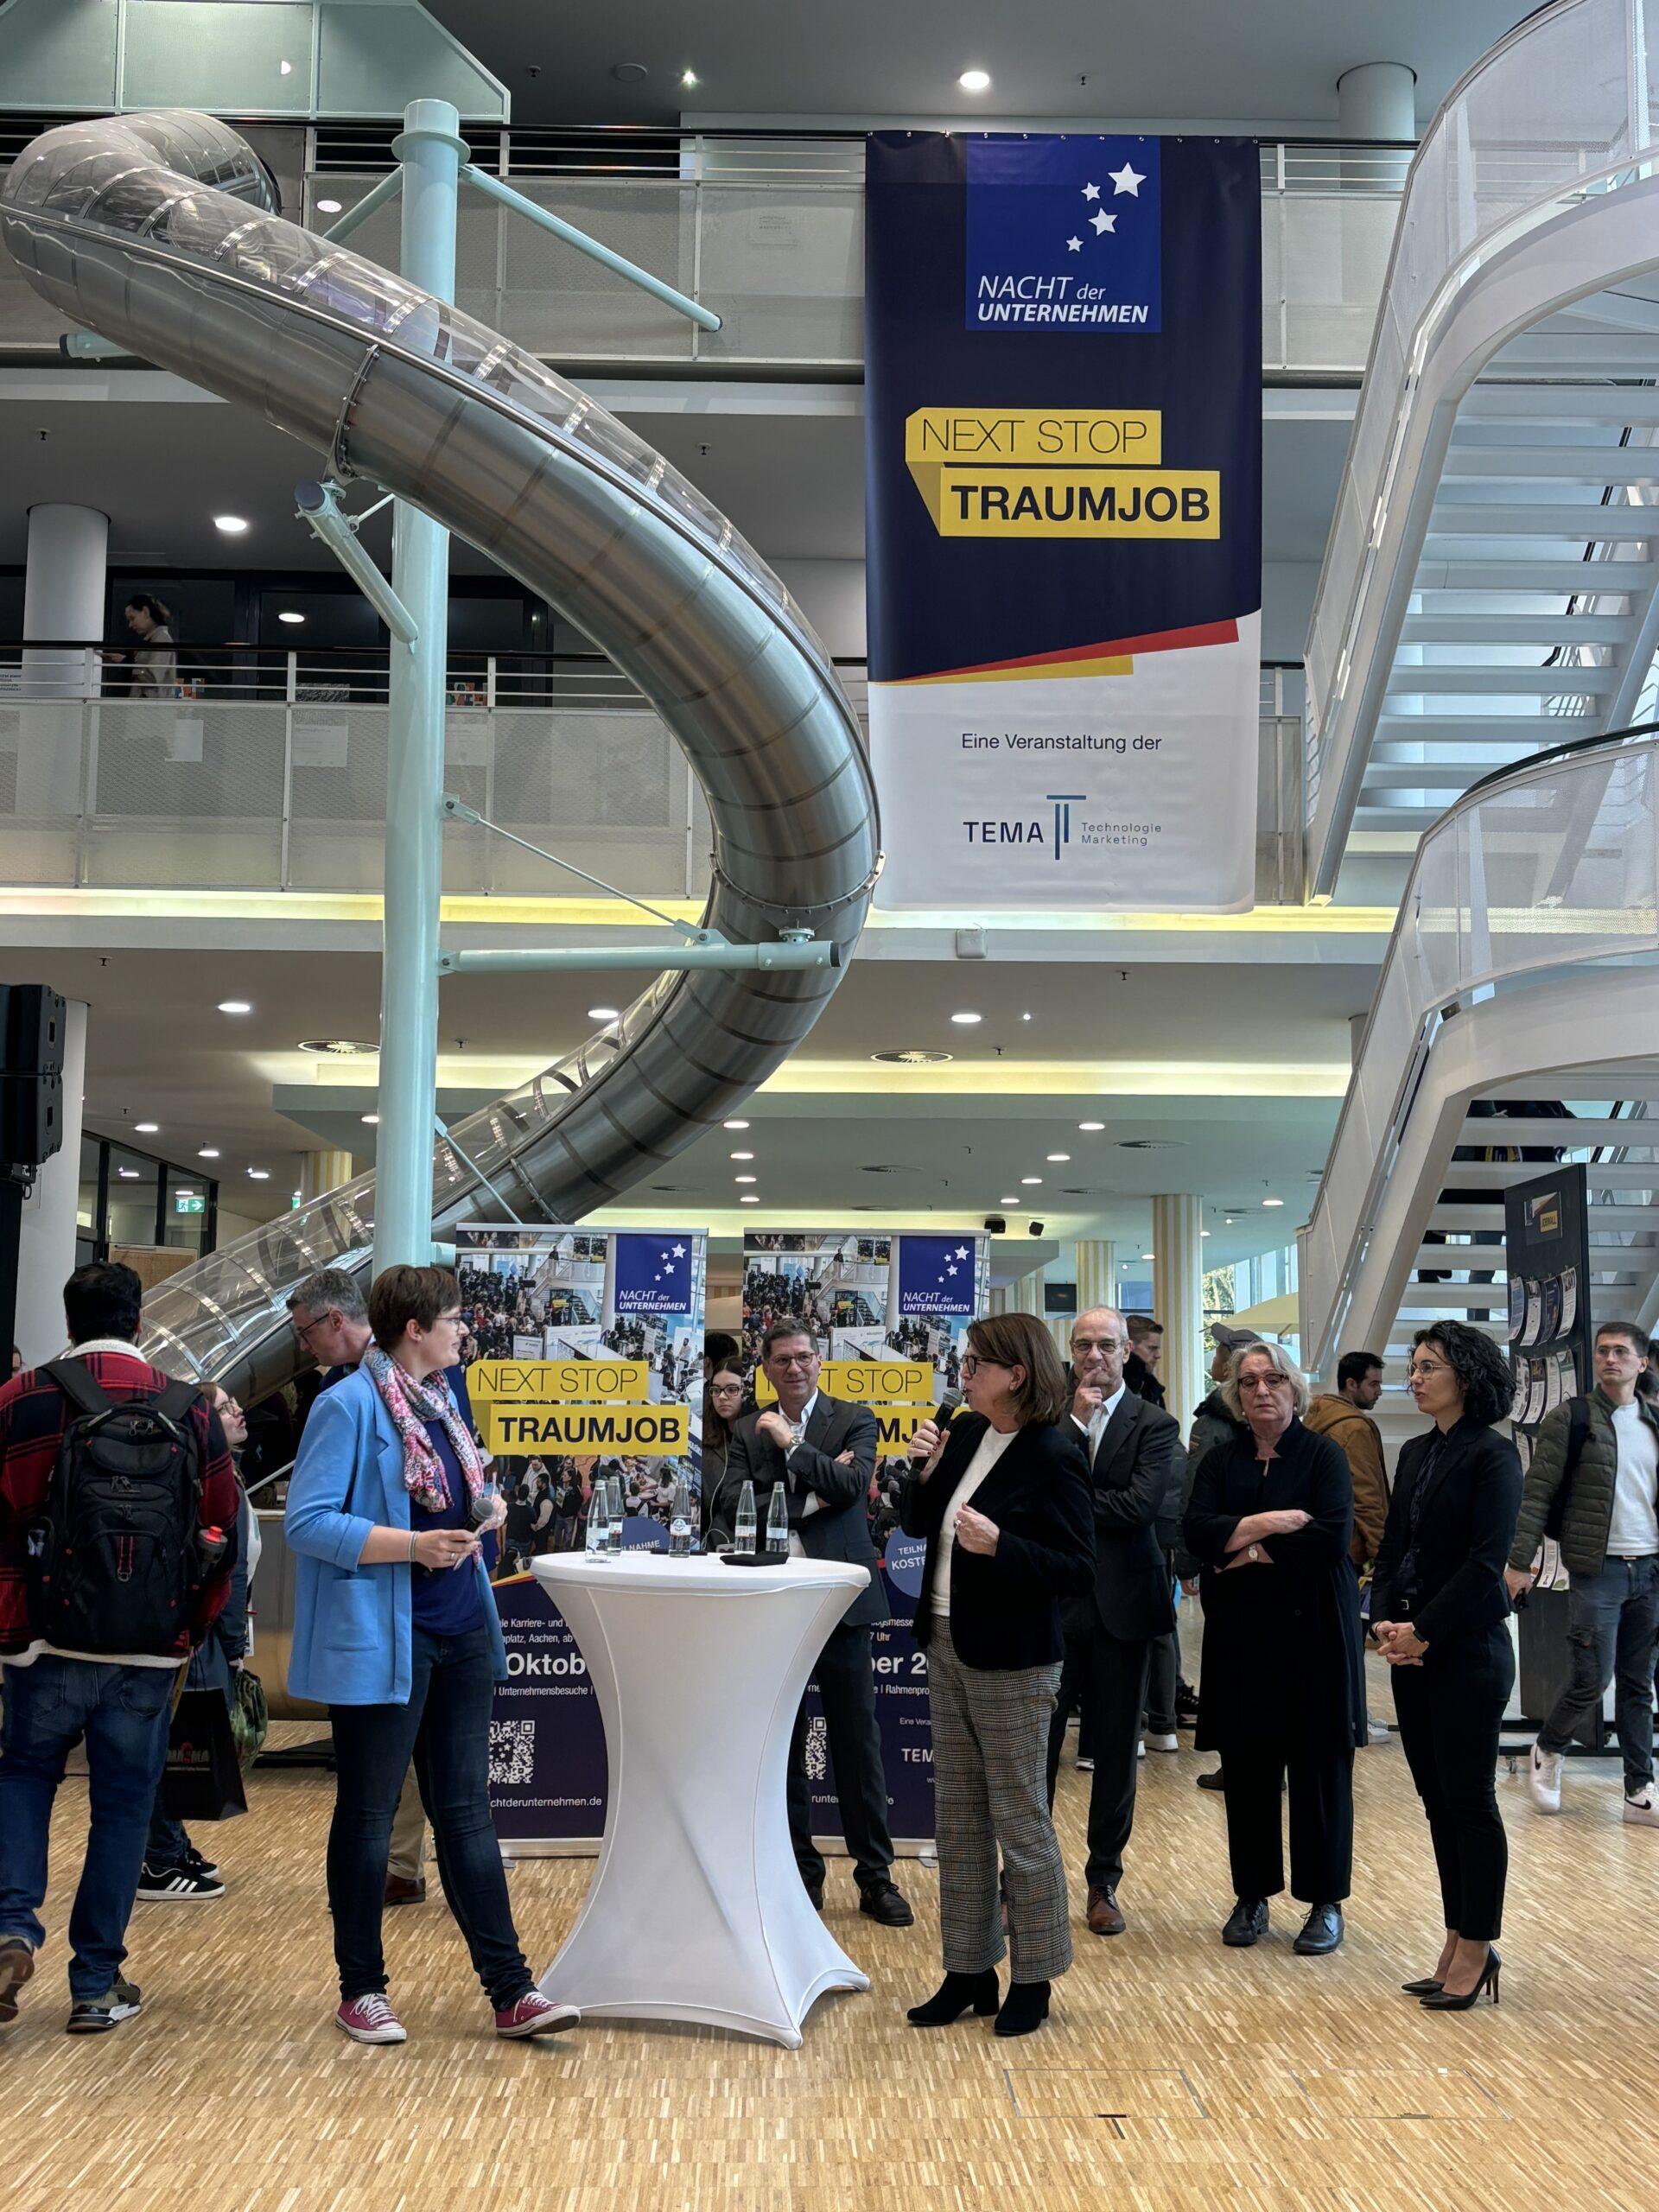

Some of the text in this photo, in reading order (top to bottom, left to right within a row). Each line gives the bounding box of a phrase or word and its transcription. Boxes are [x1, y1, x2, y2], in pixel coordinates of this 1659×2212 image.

[977, 276, 1106, 301] NACHT der
[978, 302, 1149, 323] UNTERNEHMEN
[923, 418, 1147, 454] NEXT STOP
[950, 485, 1211, 522] TRAUMJOB
[962, 733, 1162, 753] Eine Veranstaltung der
[963, 822, 1045, 843] TEMA
[1081, 822, 1162, 834] Technologie
[1081, 834, 1148, 847] Marketing
[619, 1290, 671, 1302] NACHT der
[902, 1292, 954, 1304] NACHT der
[619, 1301, 687, 1311] UNTERNEHMEN
[902, 1303, 970, 1313] UNTERNEHMEN
[478, 1368, 638, 1393] NEXT STOP
[847, 1369, 923, 1394] STOP
[498, 1416, 681, 1444] TRAUMJOB
[511, 1618, 545, 1628] Karriere-
[548, 1618, 563, 1628] und
[528, 1633, 560, 1644] Aachen,
[876, 1632, 892, 1642] Uhr
[499, 1685, 588, 1696] Unternehmensbesuche
